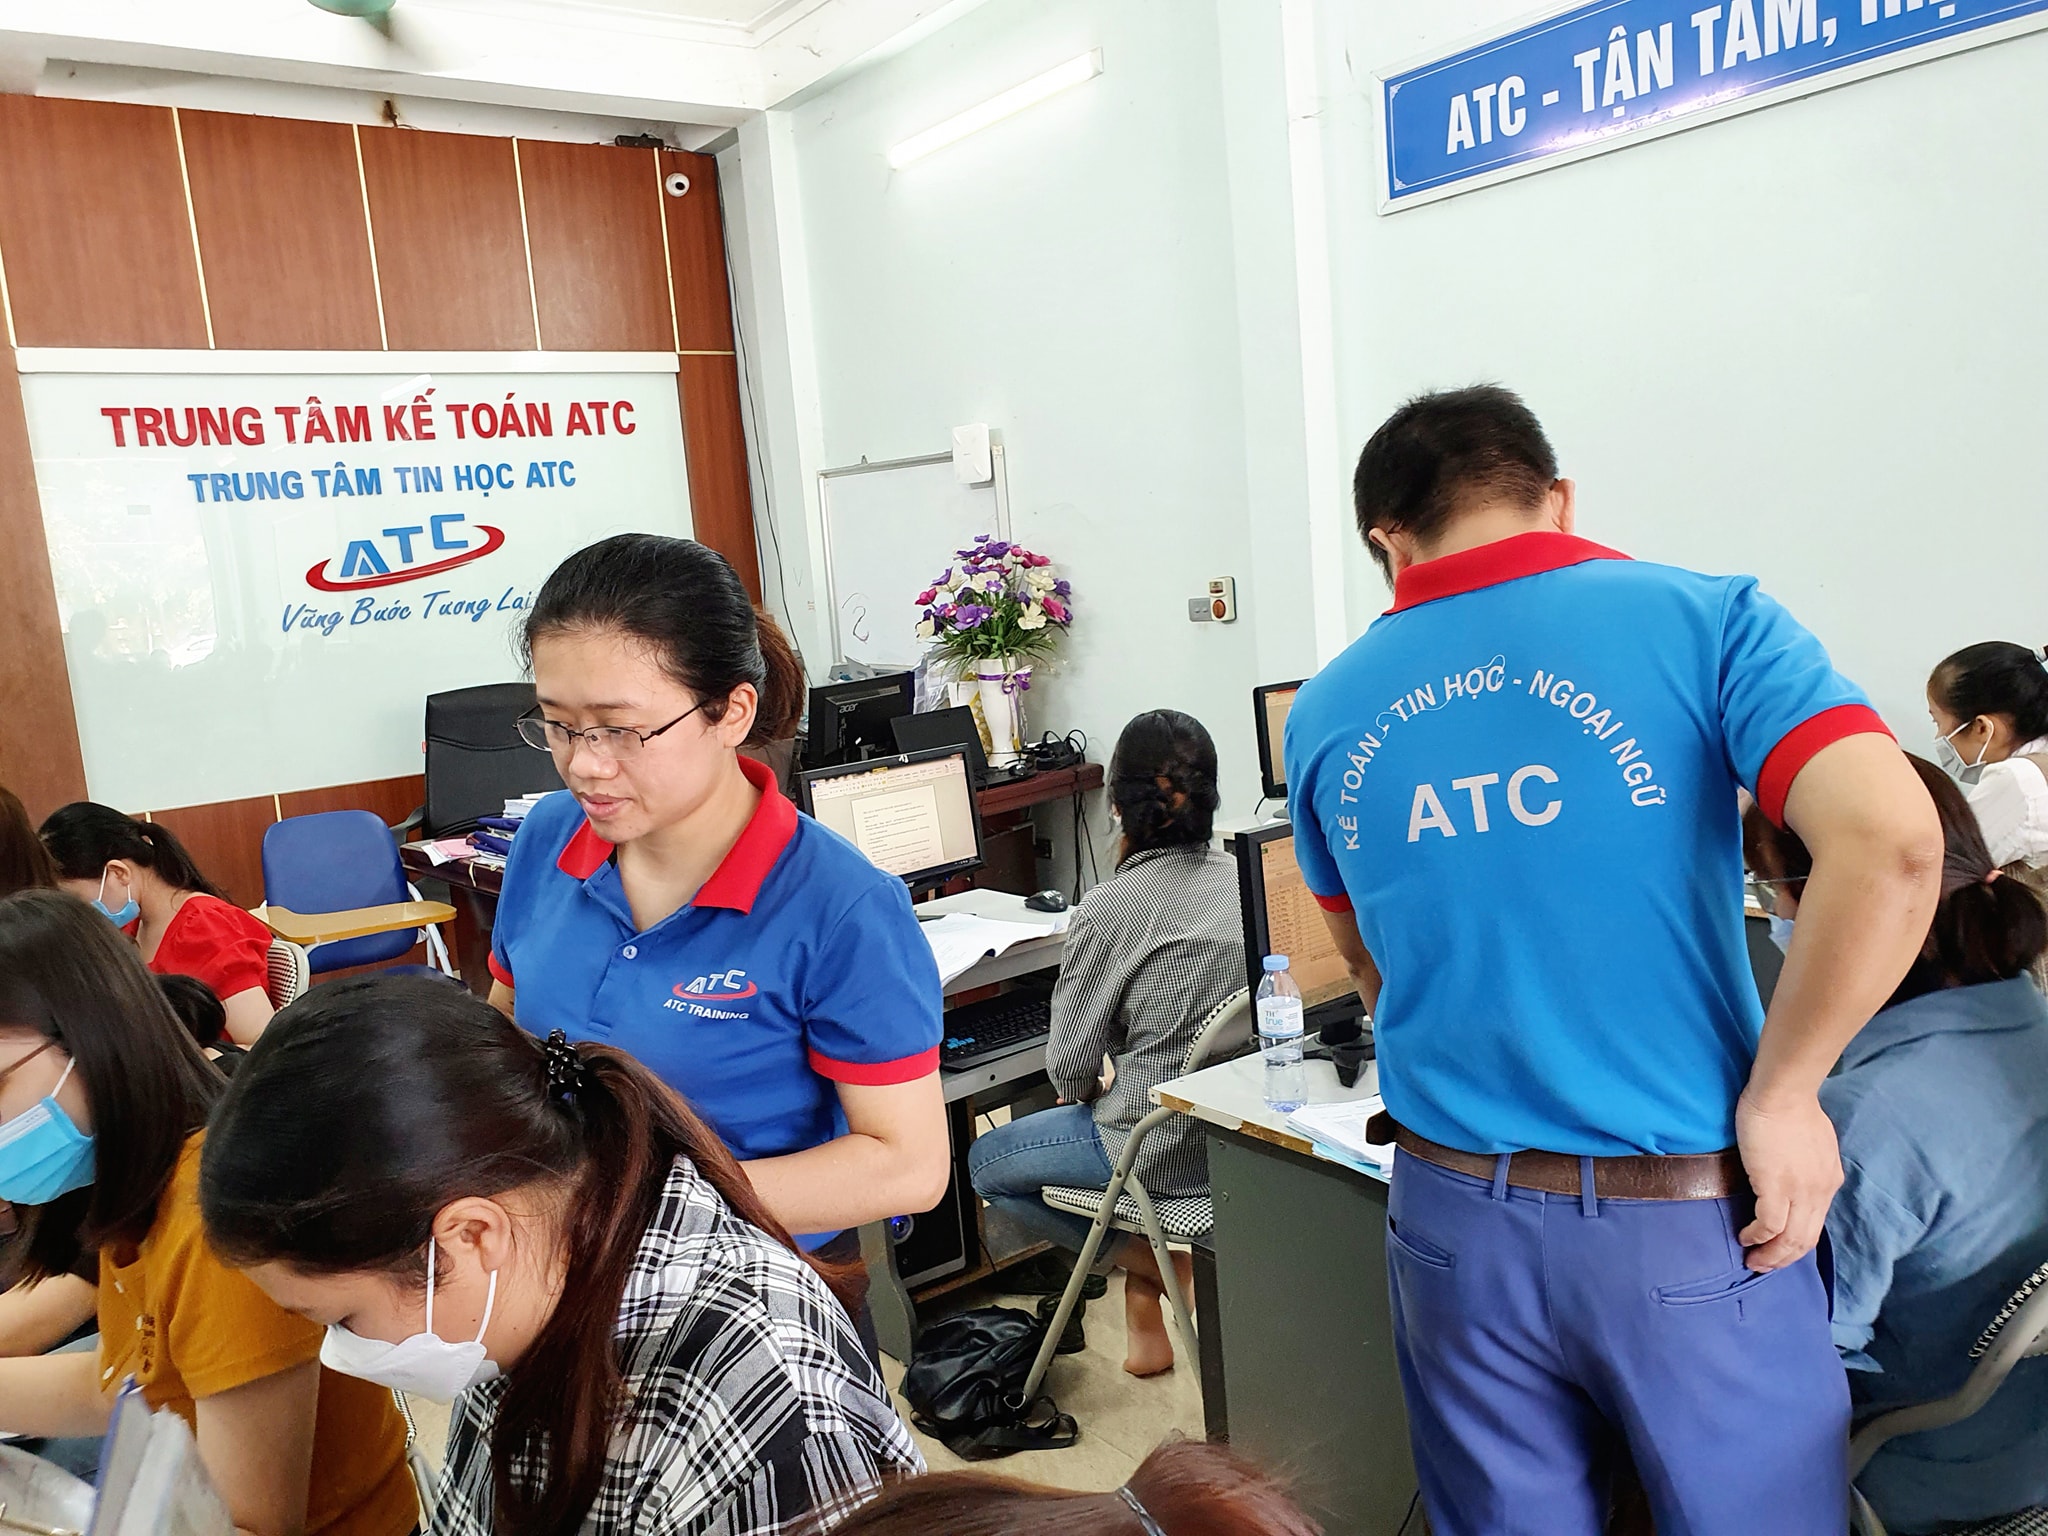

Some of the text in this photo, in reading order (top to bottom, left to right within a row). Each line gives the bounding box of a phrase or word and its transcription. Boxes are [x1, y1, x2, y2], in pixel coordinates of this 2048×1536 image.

[1446, 75, 1526, 155] ATC
[1542, 90, 1559, 107] -
[1573, 21, 1674, 119] TẬN
[101, 388, 637, 448] TRUNG TÂM KẾ TOÁN ATC
[187, 460, 577, 503] TRUNG TÂM TIN HỌC ATC
[339, 513, 470, 578] ATC
[282, 604, 345, 638] Vững
[350, 596, 413, 627] Bước
[1389, 683, 1437, 722] TIN
[1443, 665, 1506, 701] HỌC
[1512, 678, 1523, 686] -
[839, 703, 859, 714] acer
[1528, 669, 1624, 741] NGOẠI
[1340, 731, 1383, 806] TOÁN
[1609, 737, 1668, 808] NGỮ
[1407, 764, 1563, 843] ATC
[1335, 813, 1361, 851] KẾ
[684, 969, 747, 994] ATC
[663, 998, 750, 1020] ATC TRAINING
[1265, 1017, 1283, 1026] true
